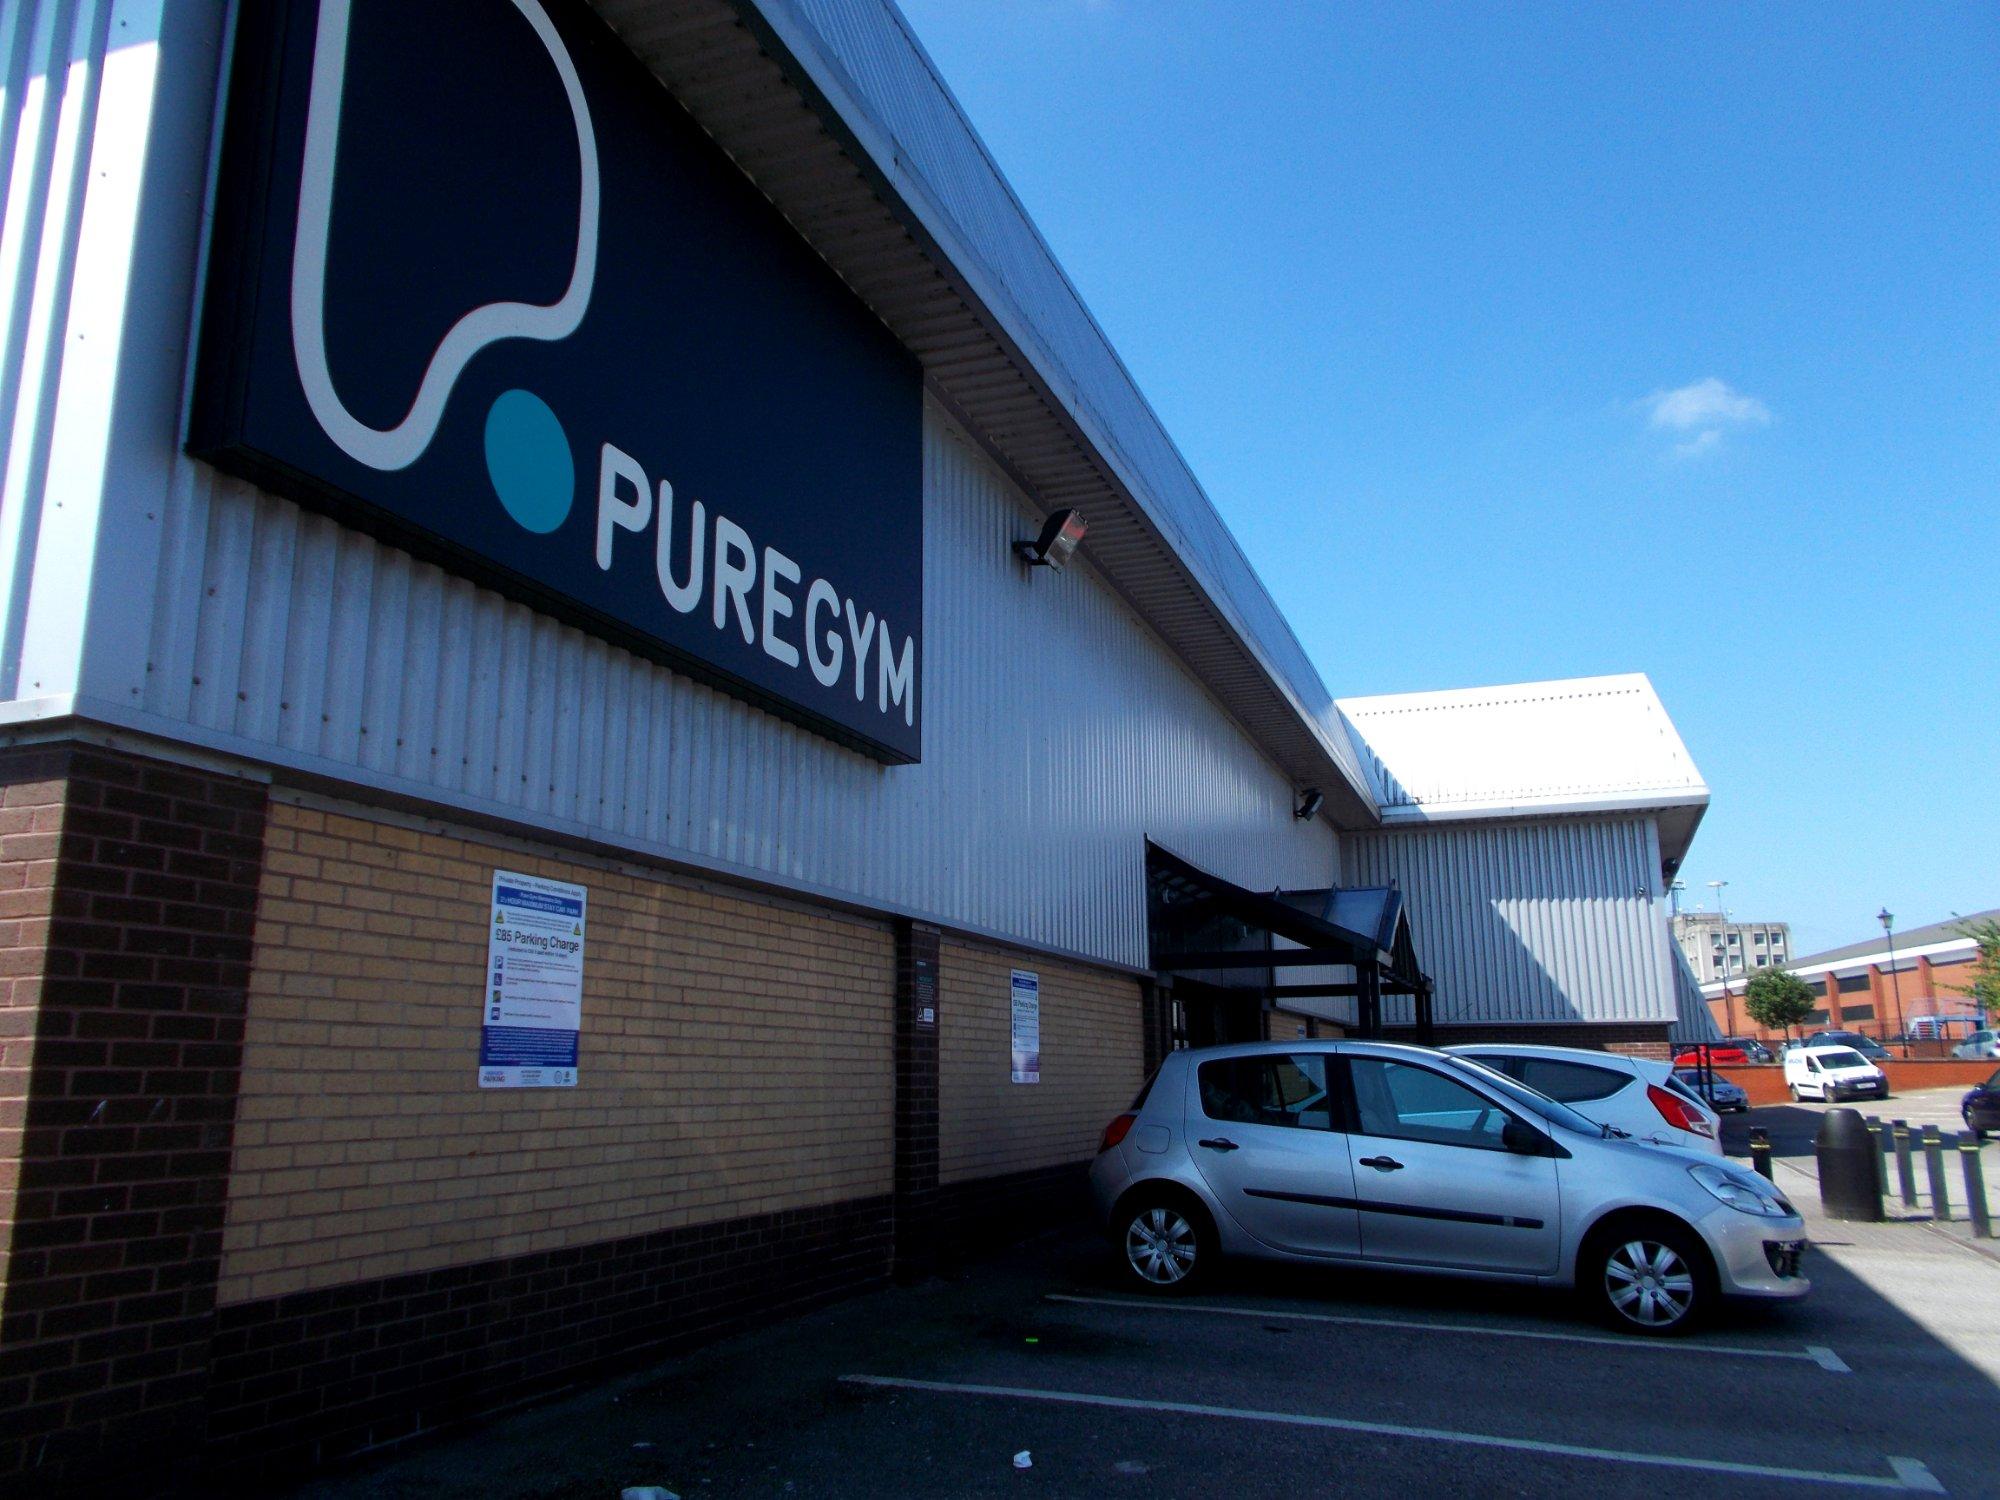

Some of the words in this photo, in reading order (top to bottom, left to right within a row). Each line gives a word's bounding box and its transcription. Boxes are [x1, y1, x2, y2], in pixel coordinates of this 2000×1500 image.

[596, 442, 914, 727] PUREGYM
[495, 928, 512, 942] £85
[514, 931, 548, 950] Parking
[550, 936, 580, 953] Charge
